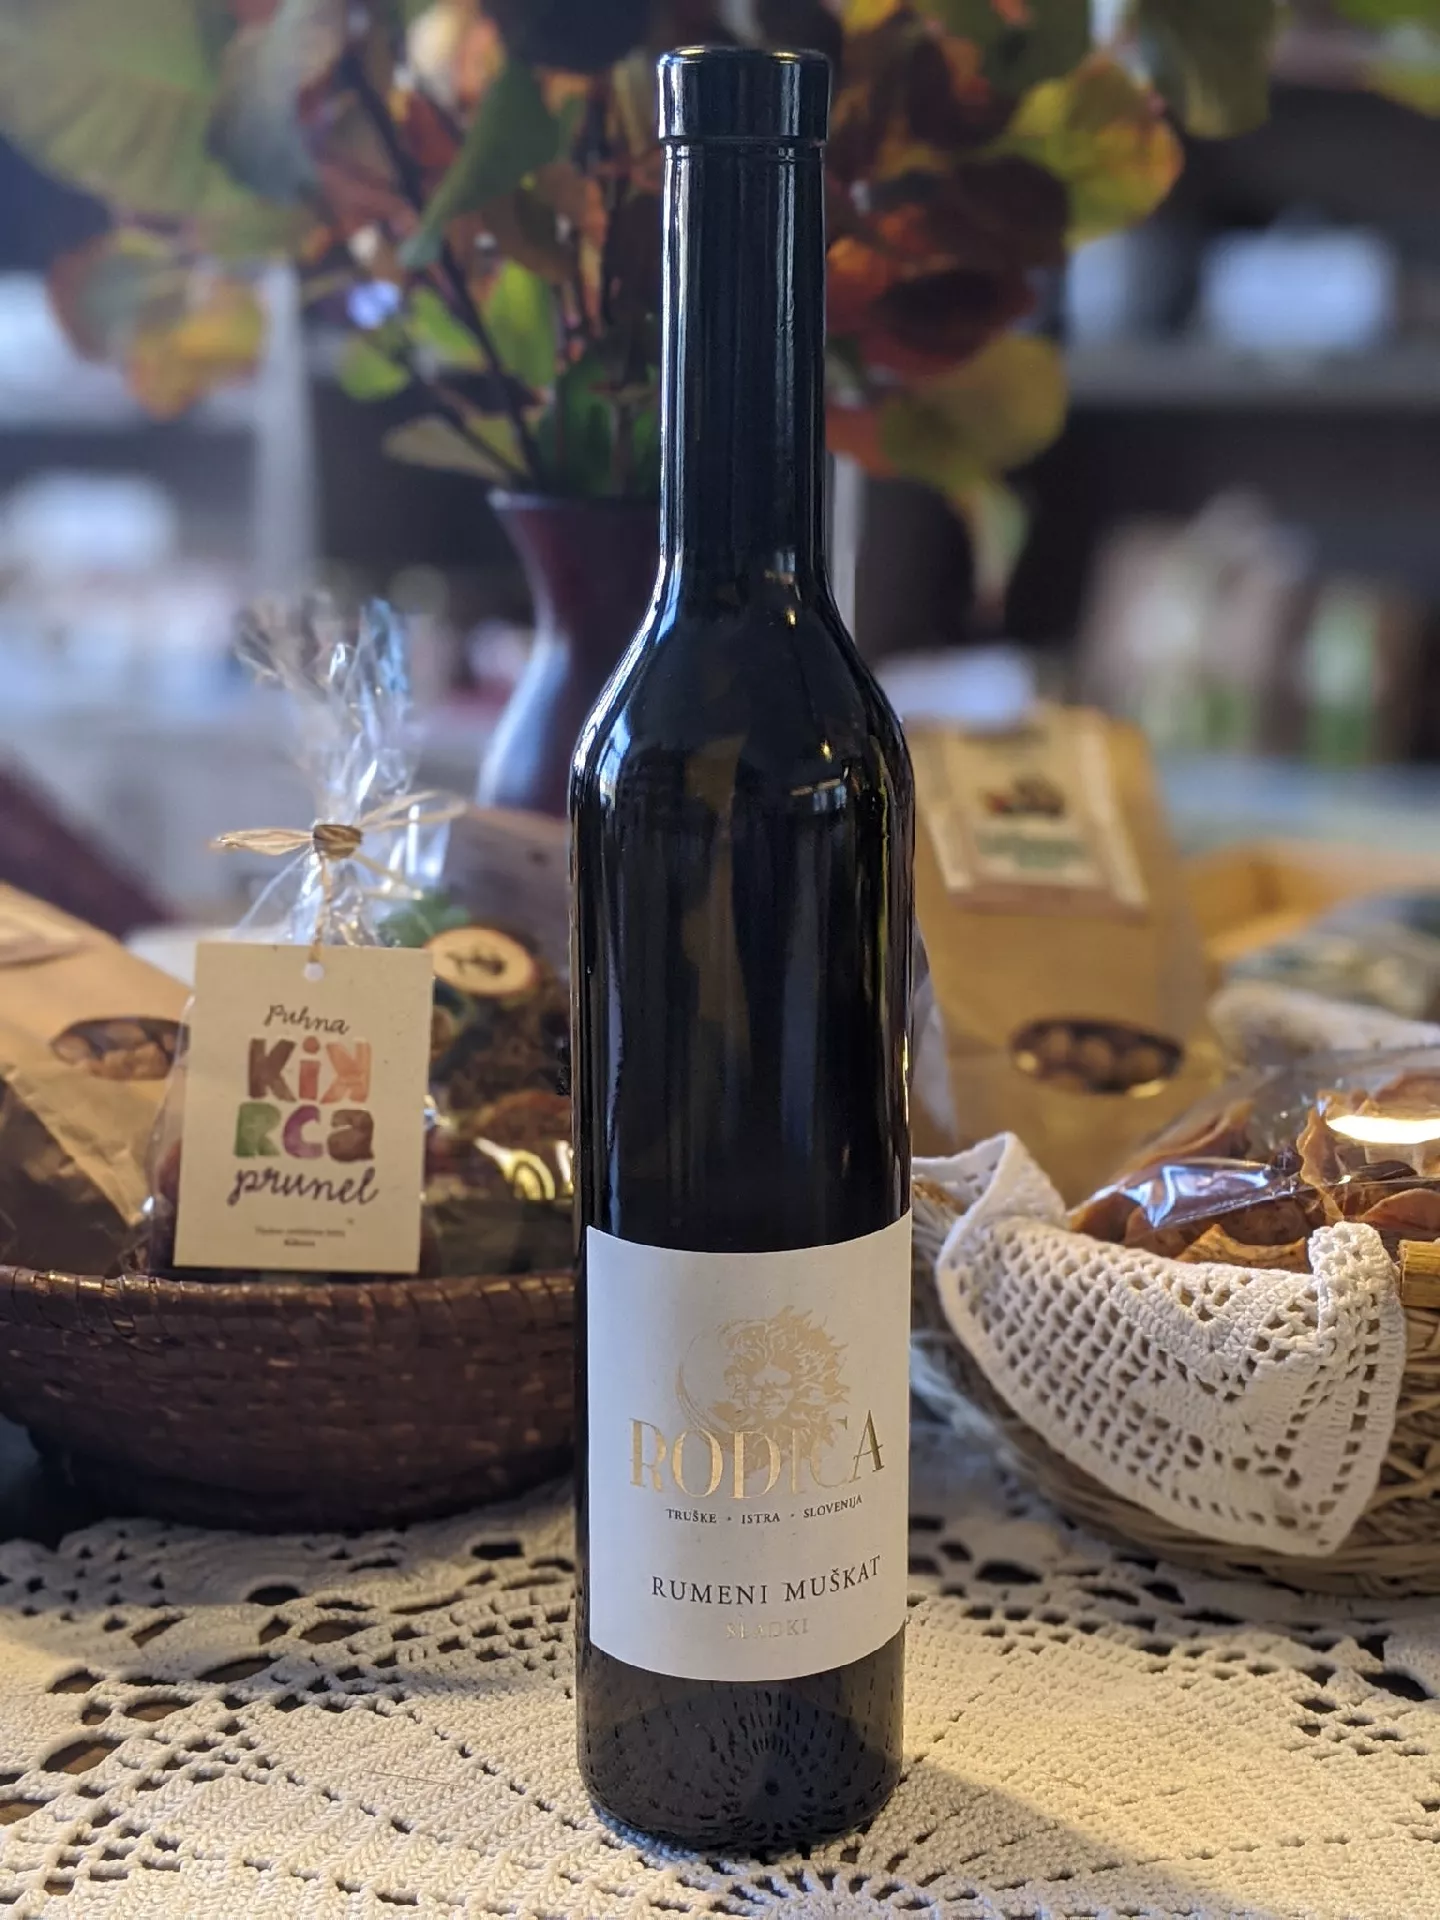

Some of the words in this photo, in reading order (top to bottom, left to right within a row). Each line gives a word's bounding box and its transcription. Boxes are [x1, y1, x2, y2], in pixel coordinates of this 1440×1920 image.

[227, 1166, 379, 1207] prunel
[629, 1410, 884, 1500] RODICA
[666, 1508, 717, 1524] TRUŠKE
[741, 1513, 781, 1525] ISTRA
[803, 1495, 863, 1519] SLOVENIJA
[652, 1576, 767, 1605] RUMENI
[785, 1555, 881, 1602] MUŠKAT
[726, 1617, 809, 1639] SLADKI
